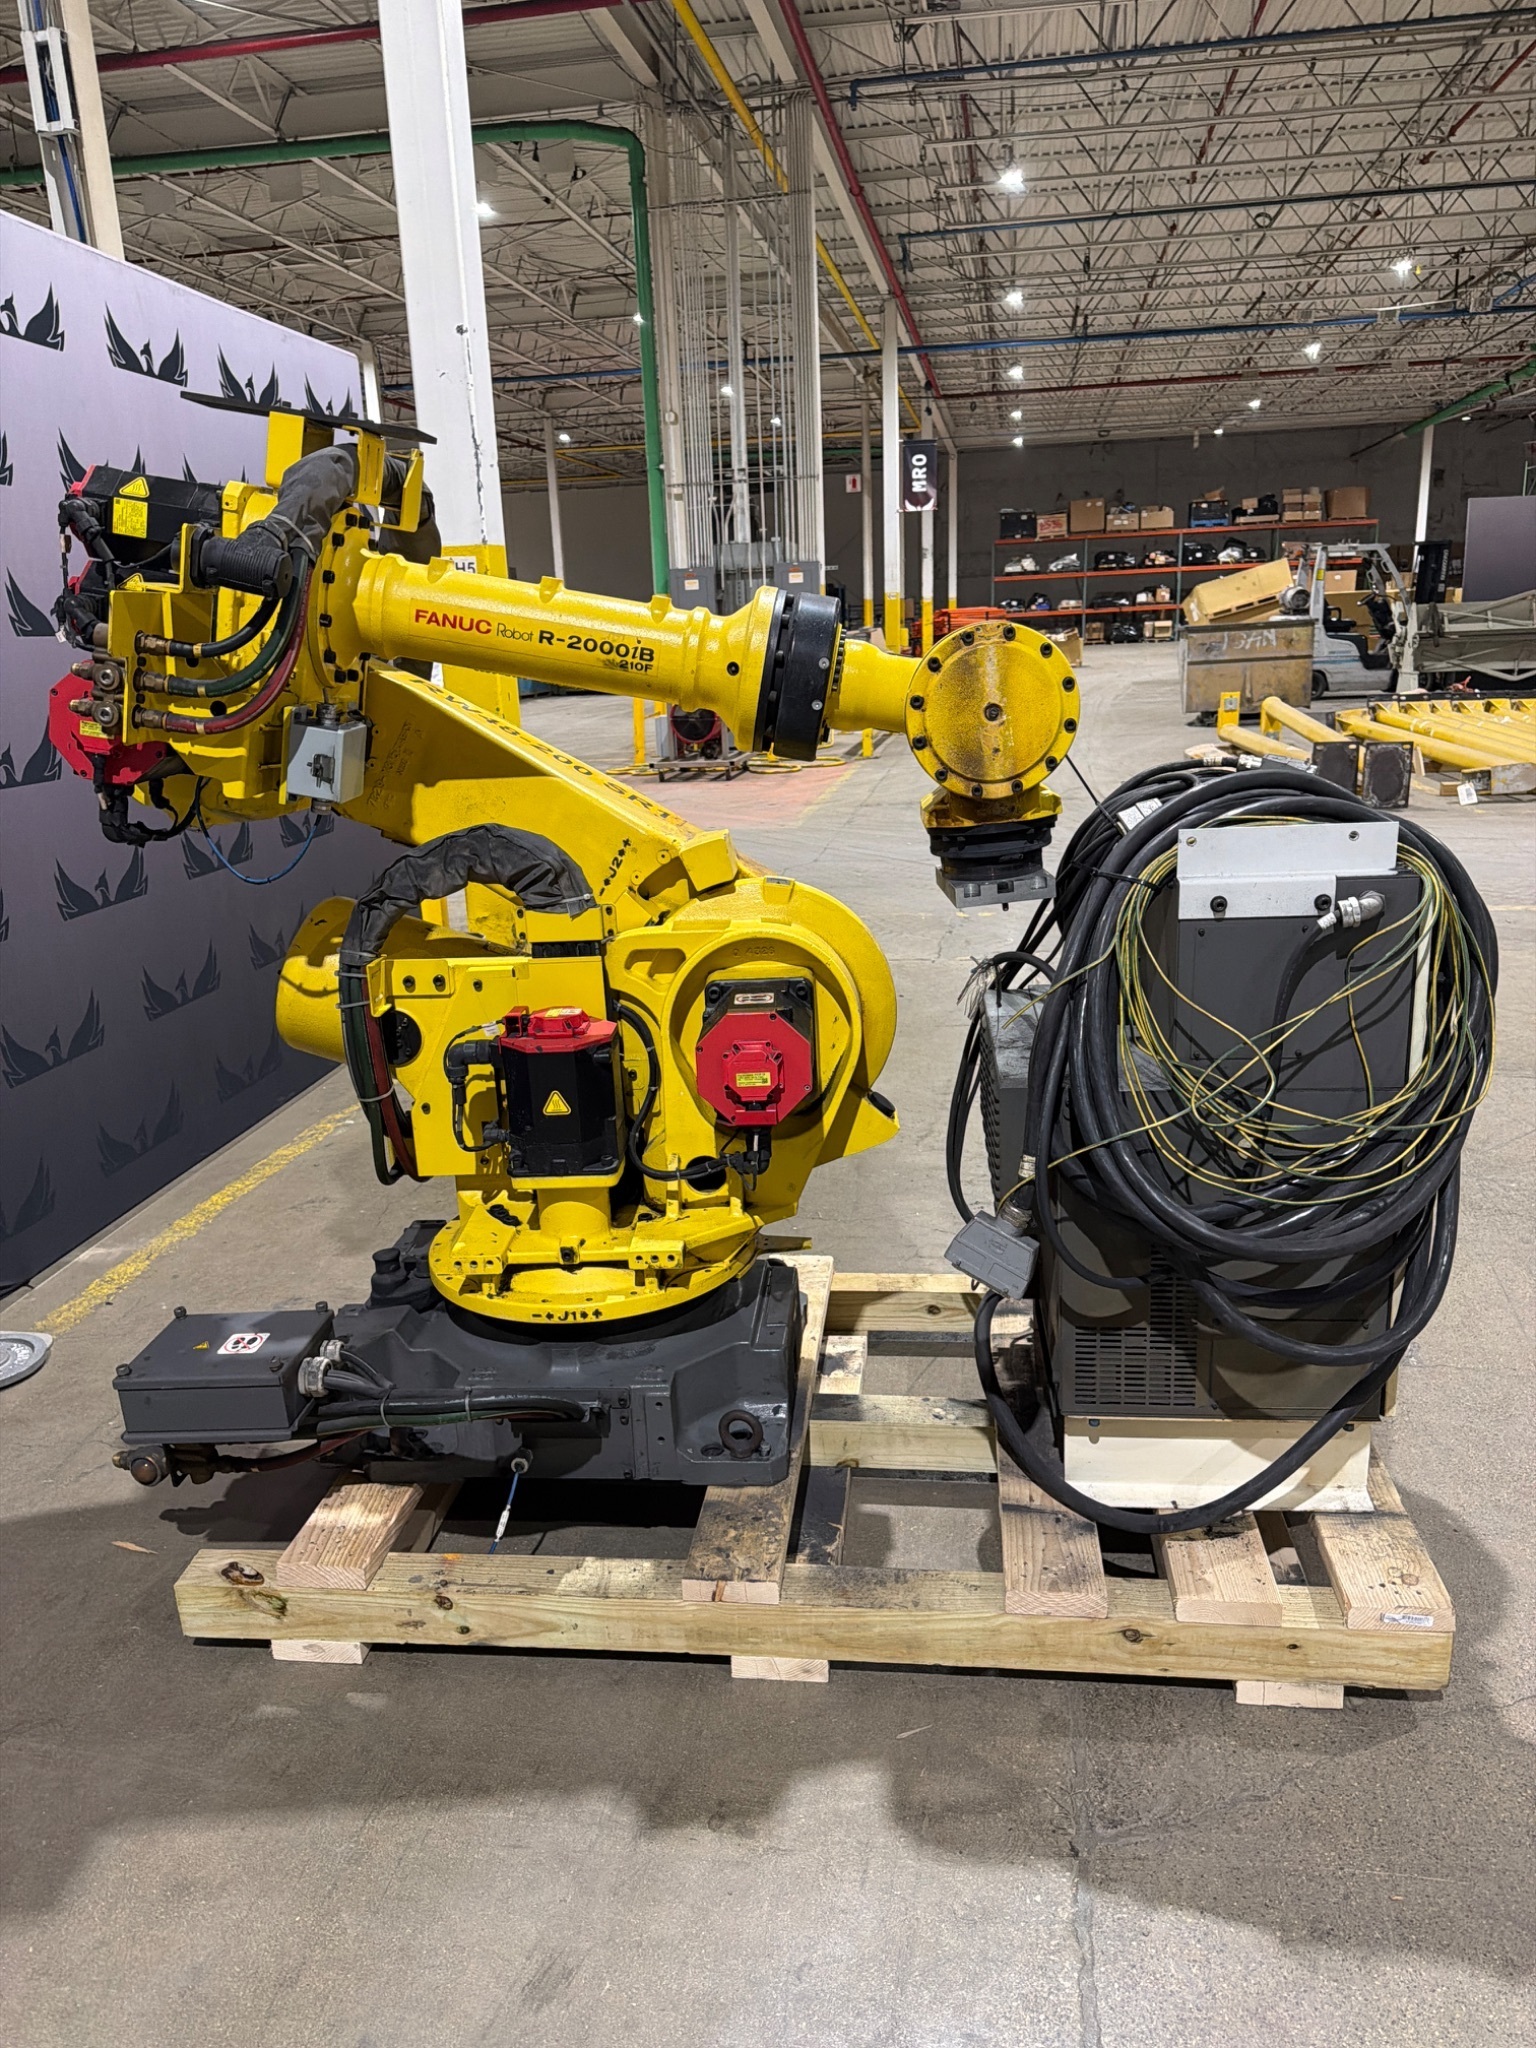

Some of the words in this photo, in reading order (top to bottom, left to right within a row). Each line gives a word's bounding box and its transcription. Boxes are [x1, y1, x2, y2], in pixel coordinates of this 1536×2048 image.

[911, 453, 927, 493] MRO
[415, 608, 492, 635] FANUC
[496, 622, 534, 642] Robot
[538, 629, 655, 663] R-2000iB
[619, 659, 654, 673] 210F
[609, 857, 623, 879] J2
[557, 1310, 577, 1322] J1
